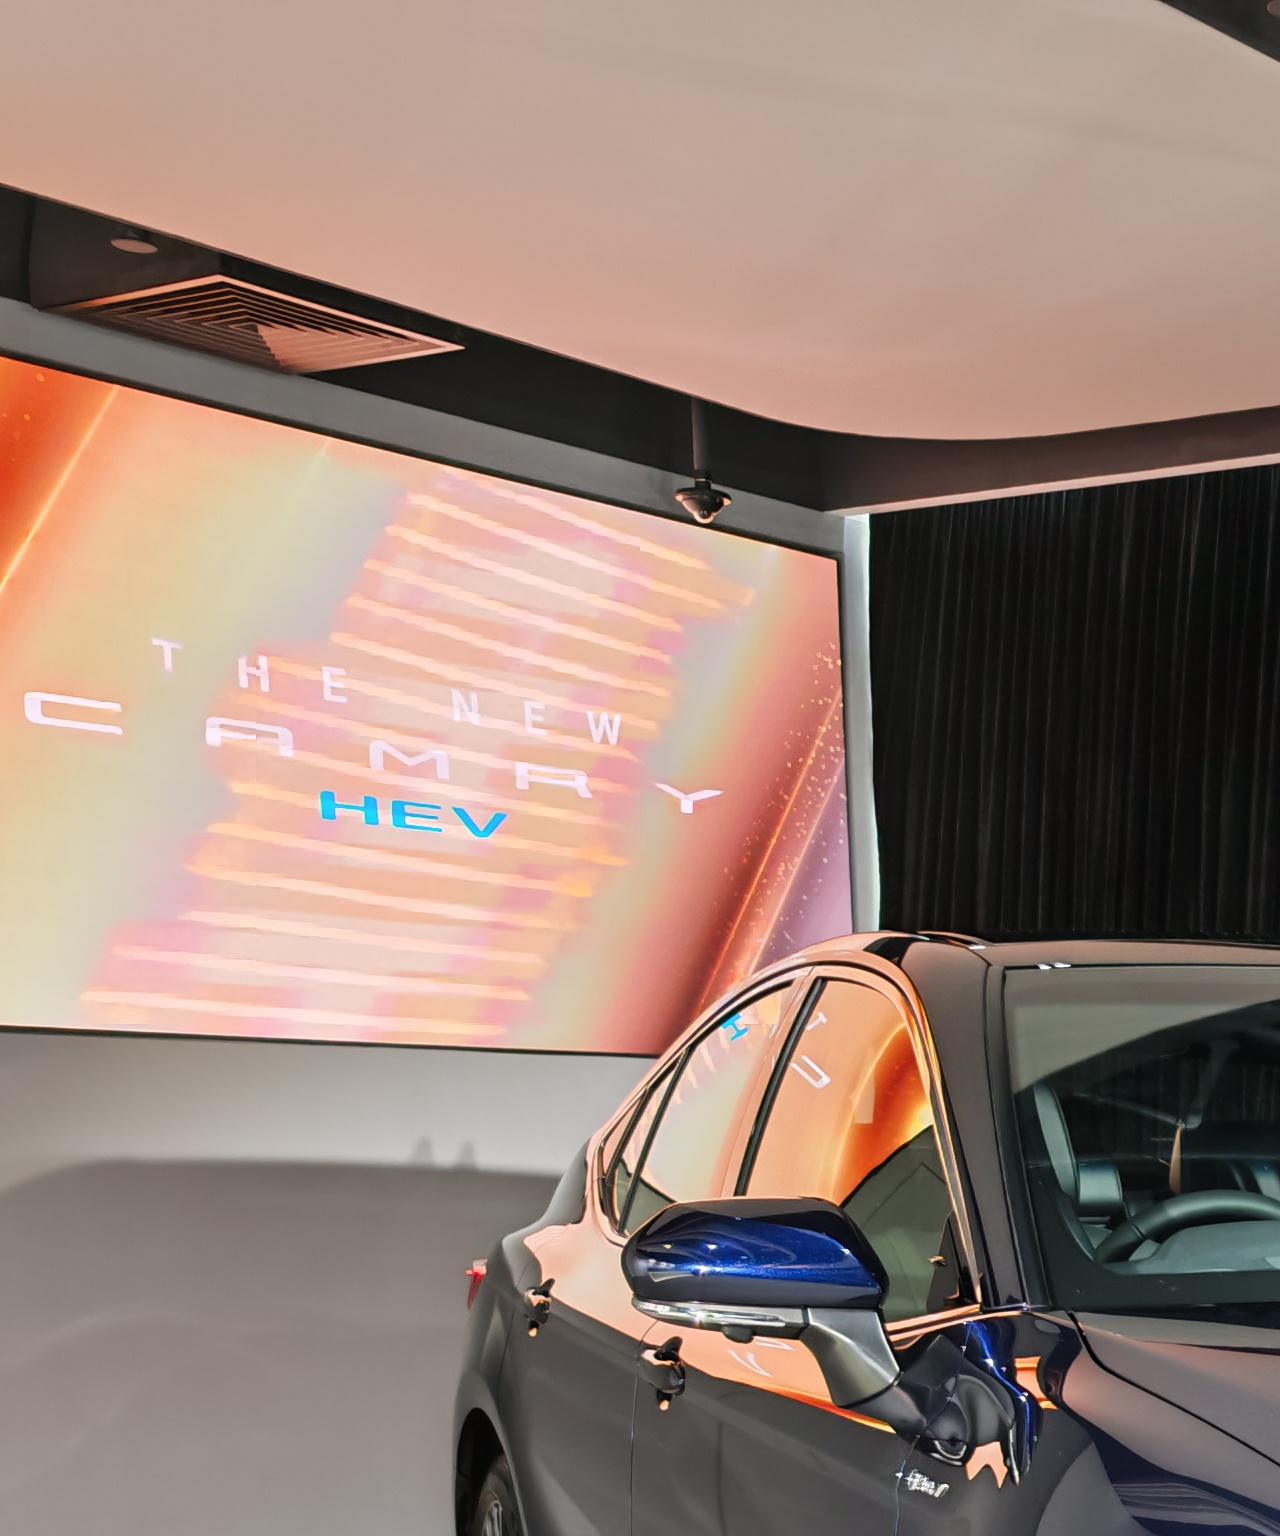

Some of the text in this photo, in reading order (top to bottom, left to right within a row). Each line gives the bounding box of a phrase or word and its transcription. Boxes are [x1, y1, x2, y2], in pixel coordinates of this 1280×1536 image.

[151, 639, 623, 746] THE NEW
[24, 691, 724, 814] CAMRY
[319, 790, 507, 839] HEV
